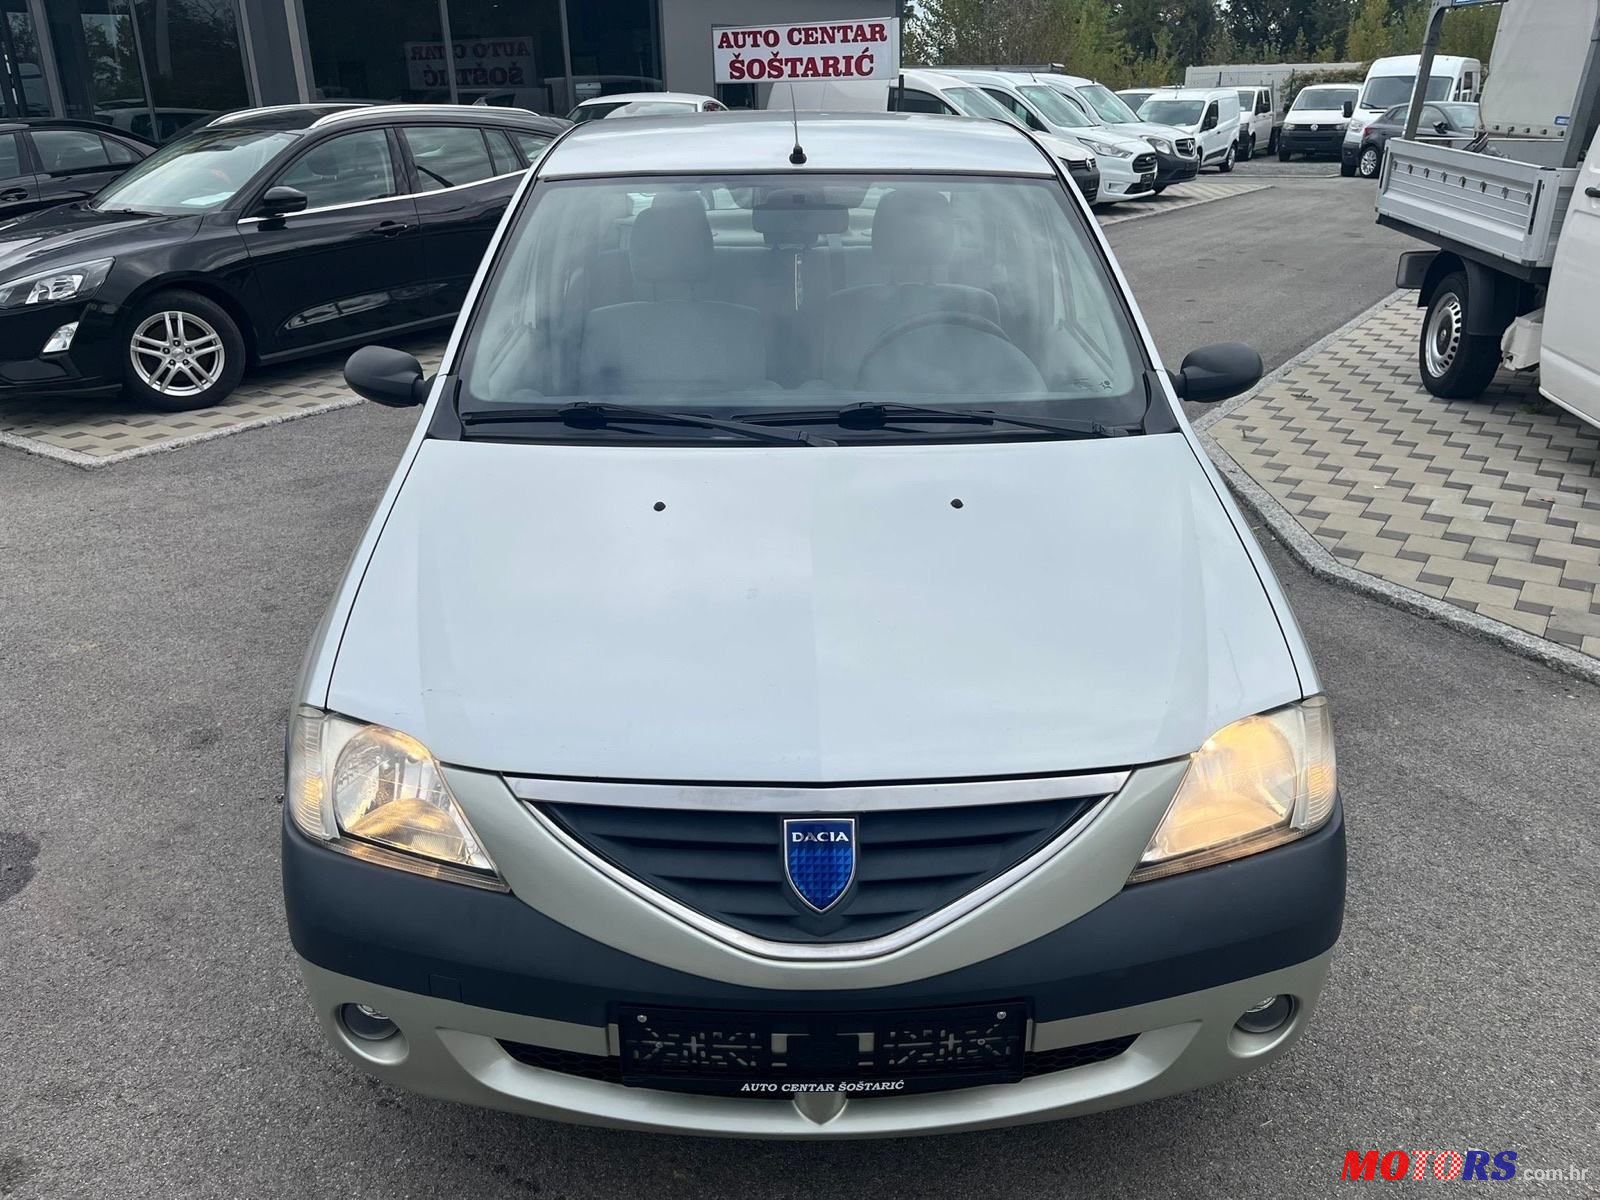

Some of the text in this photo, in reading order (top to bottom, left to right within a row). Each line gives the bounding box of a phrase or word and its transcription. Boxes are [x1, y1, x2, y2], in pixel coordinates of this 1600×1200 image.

[718, 23, 888, 49] AUTO CENTAR
[729, 47, 874, 80] ŠOŠTARIĆ
[791, 831, 849, 843] DACIA
[741, 1079, 905, 1092] AUTO CENTAR ŠOŠTARIĆ
